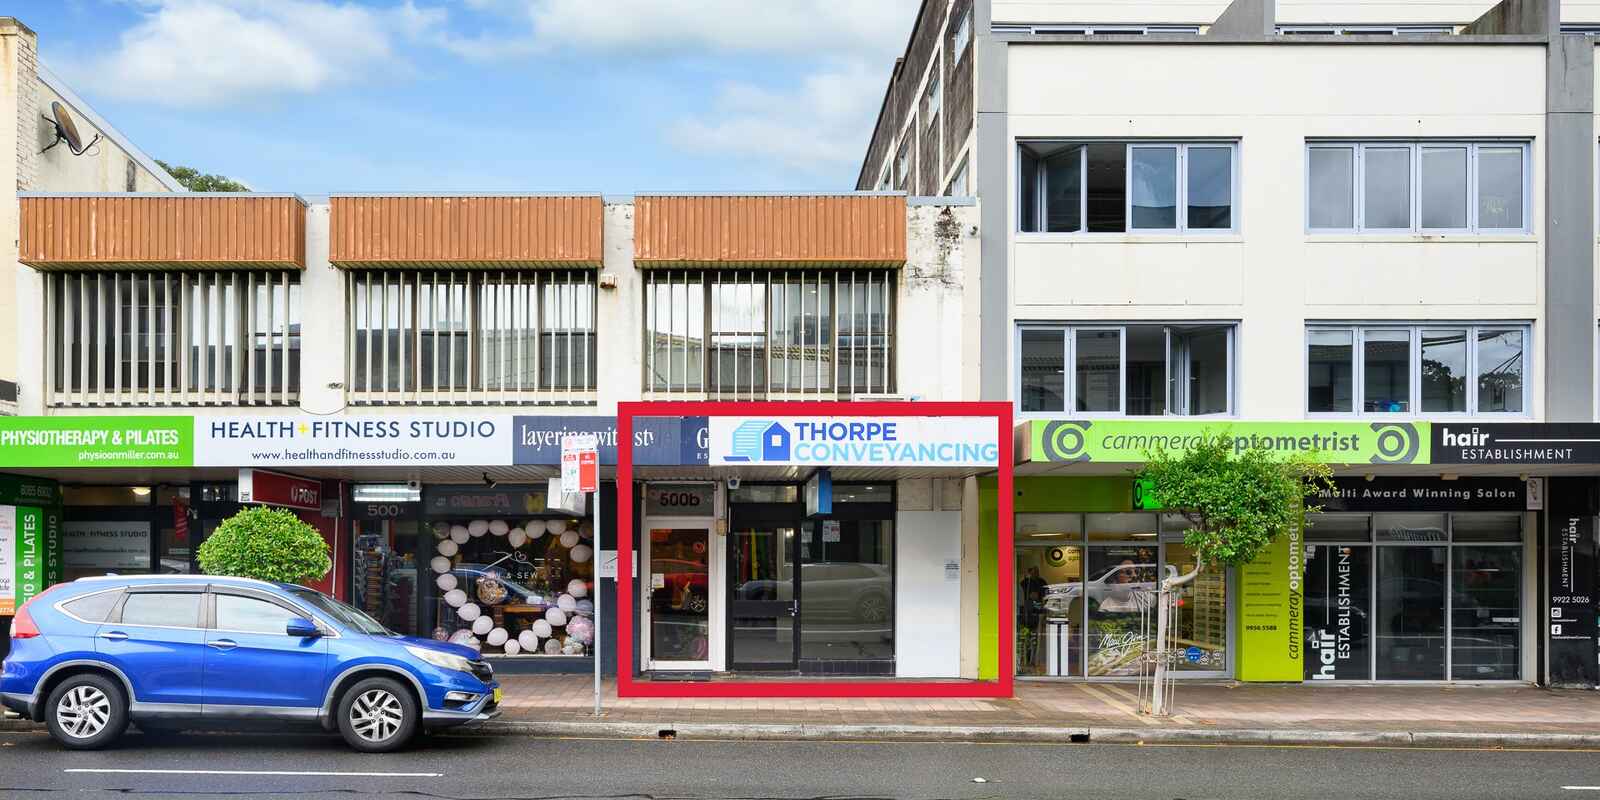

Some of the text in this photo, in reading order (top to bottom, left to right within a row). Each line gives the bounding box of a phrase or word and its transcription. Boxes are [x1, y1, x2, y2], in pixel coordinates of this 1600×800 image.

[1, 430, 179, 446] PHYSIOTHERAPY & PILATES
[409, 421, 496, 438] STUDIO
[794, 422, 897, 441] THORPE
[1442, 427, 1490, 447] hair
[78, 451, 180, 462] physioonmiller.com.au
[251, 448, 456, 461] www.healthandfitnessstudio.com.au
[794, 443, 998, 462] CONVEYANCING
[1461, 449, 1574, 460] ESTABLISHMENT
[659, 493, 700, 506] 500b
[1363, 488, 1407, 498] Award
[1413, 488, 1471, 500] Winning
[1477, 488, 1517, 498] Salon
[1568, 517, 1580, 544] hair
[24, 514, 36, 567] PILATES
[1338, 545, 1351, 659] ESTABLISHMENT
[1312, 628, 1335, 680] hair
